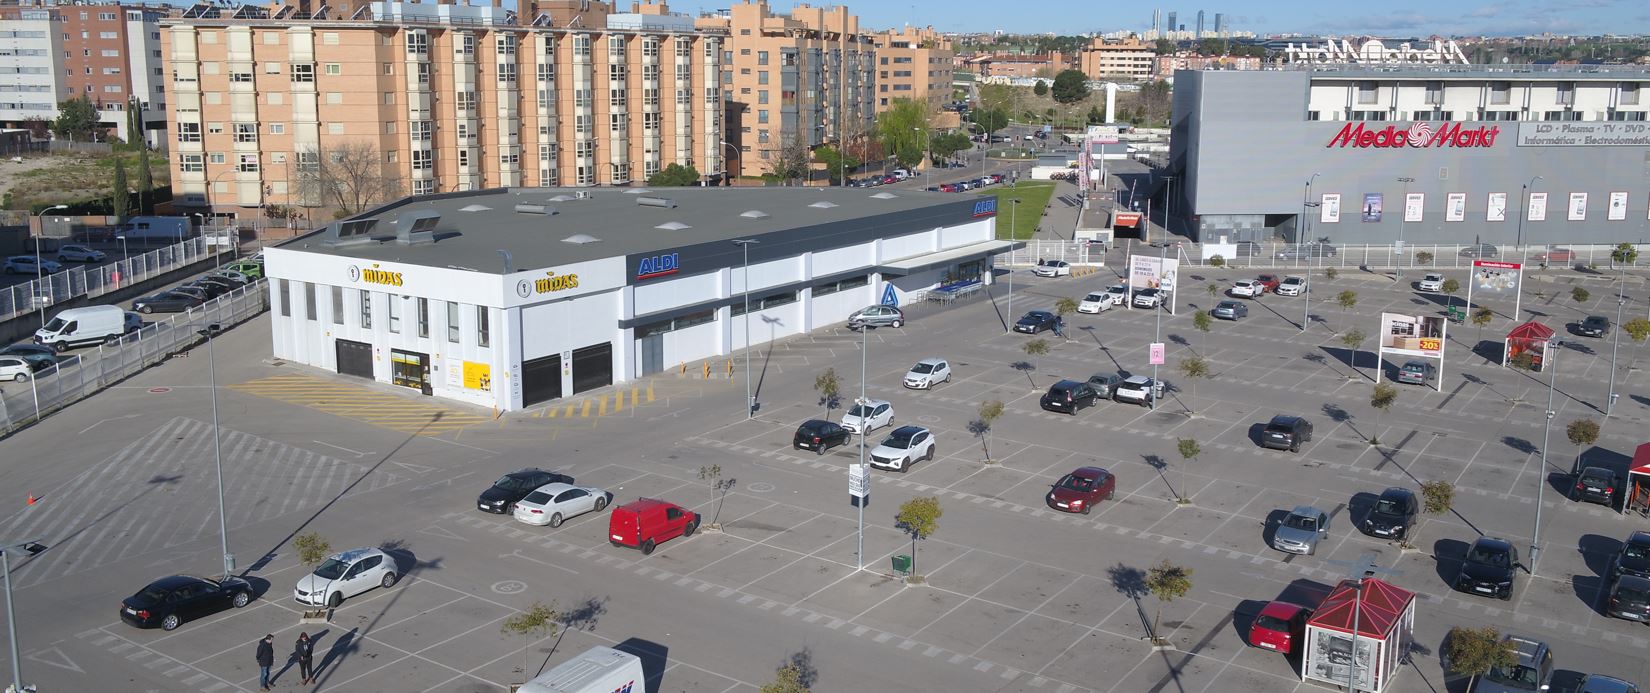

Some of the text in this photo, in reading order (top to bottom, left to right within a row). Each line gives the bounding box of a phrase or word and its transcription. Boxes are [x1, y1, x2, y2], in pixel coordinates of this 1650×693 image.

[1536, 124, 1645, 133] LCD Plasma TV DVD
[975, 199, 996, 214] ALDI
[639, 253, 679, 275] ALDI
